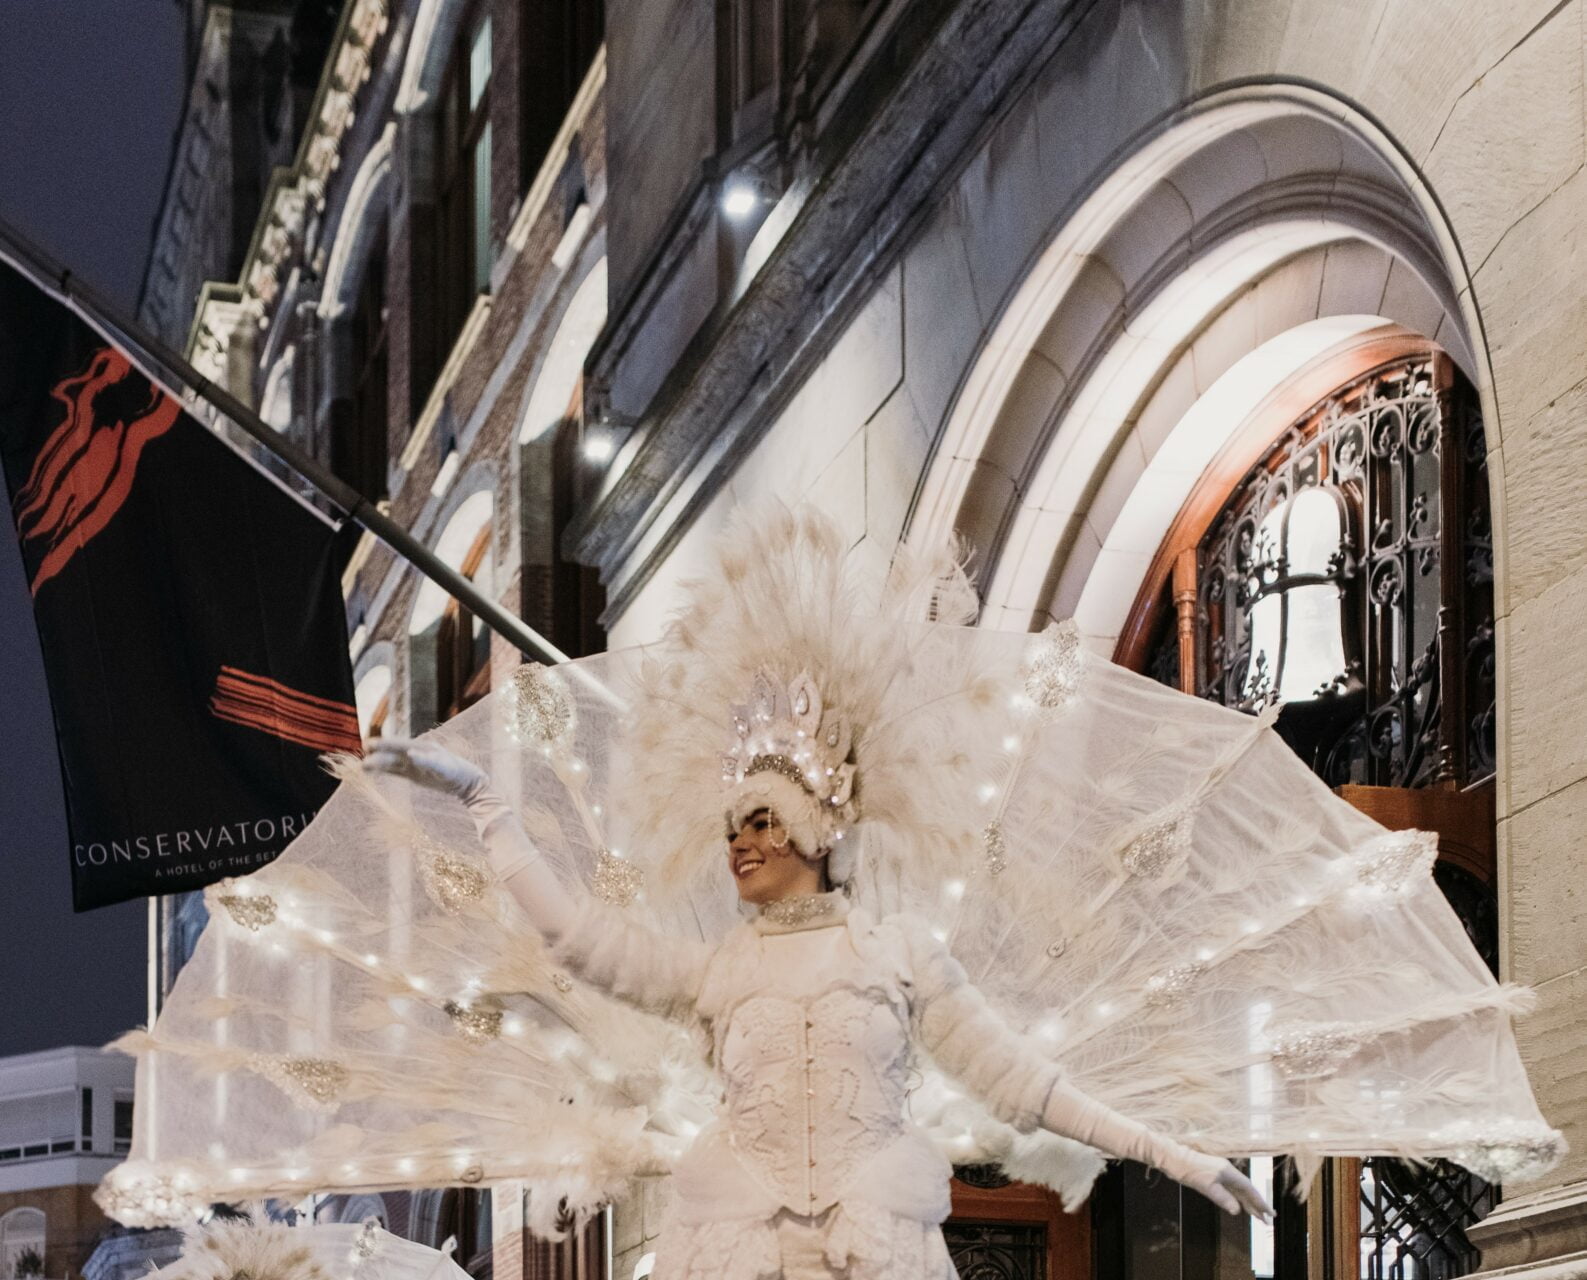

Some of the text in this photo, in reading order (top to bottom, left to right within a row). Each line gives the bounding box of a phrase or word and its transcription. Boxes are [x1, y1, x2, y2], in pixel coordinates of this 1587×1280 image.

[75, 811, 317, 867] CONSERVATORI
[155, 868, 163, 878] A
[166, 863, 205, 877] HOTEL
[208, 859, 223, 871] OF
[229, 855, 251, 867] THE
